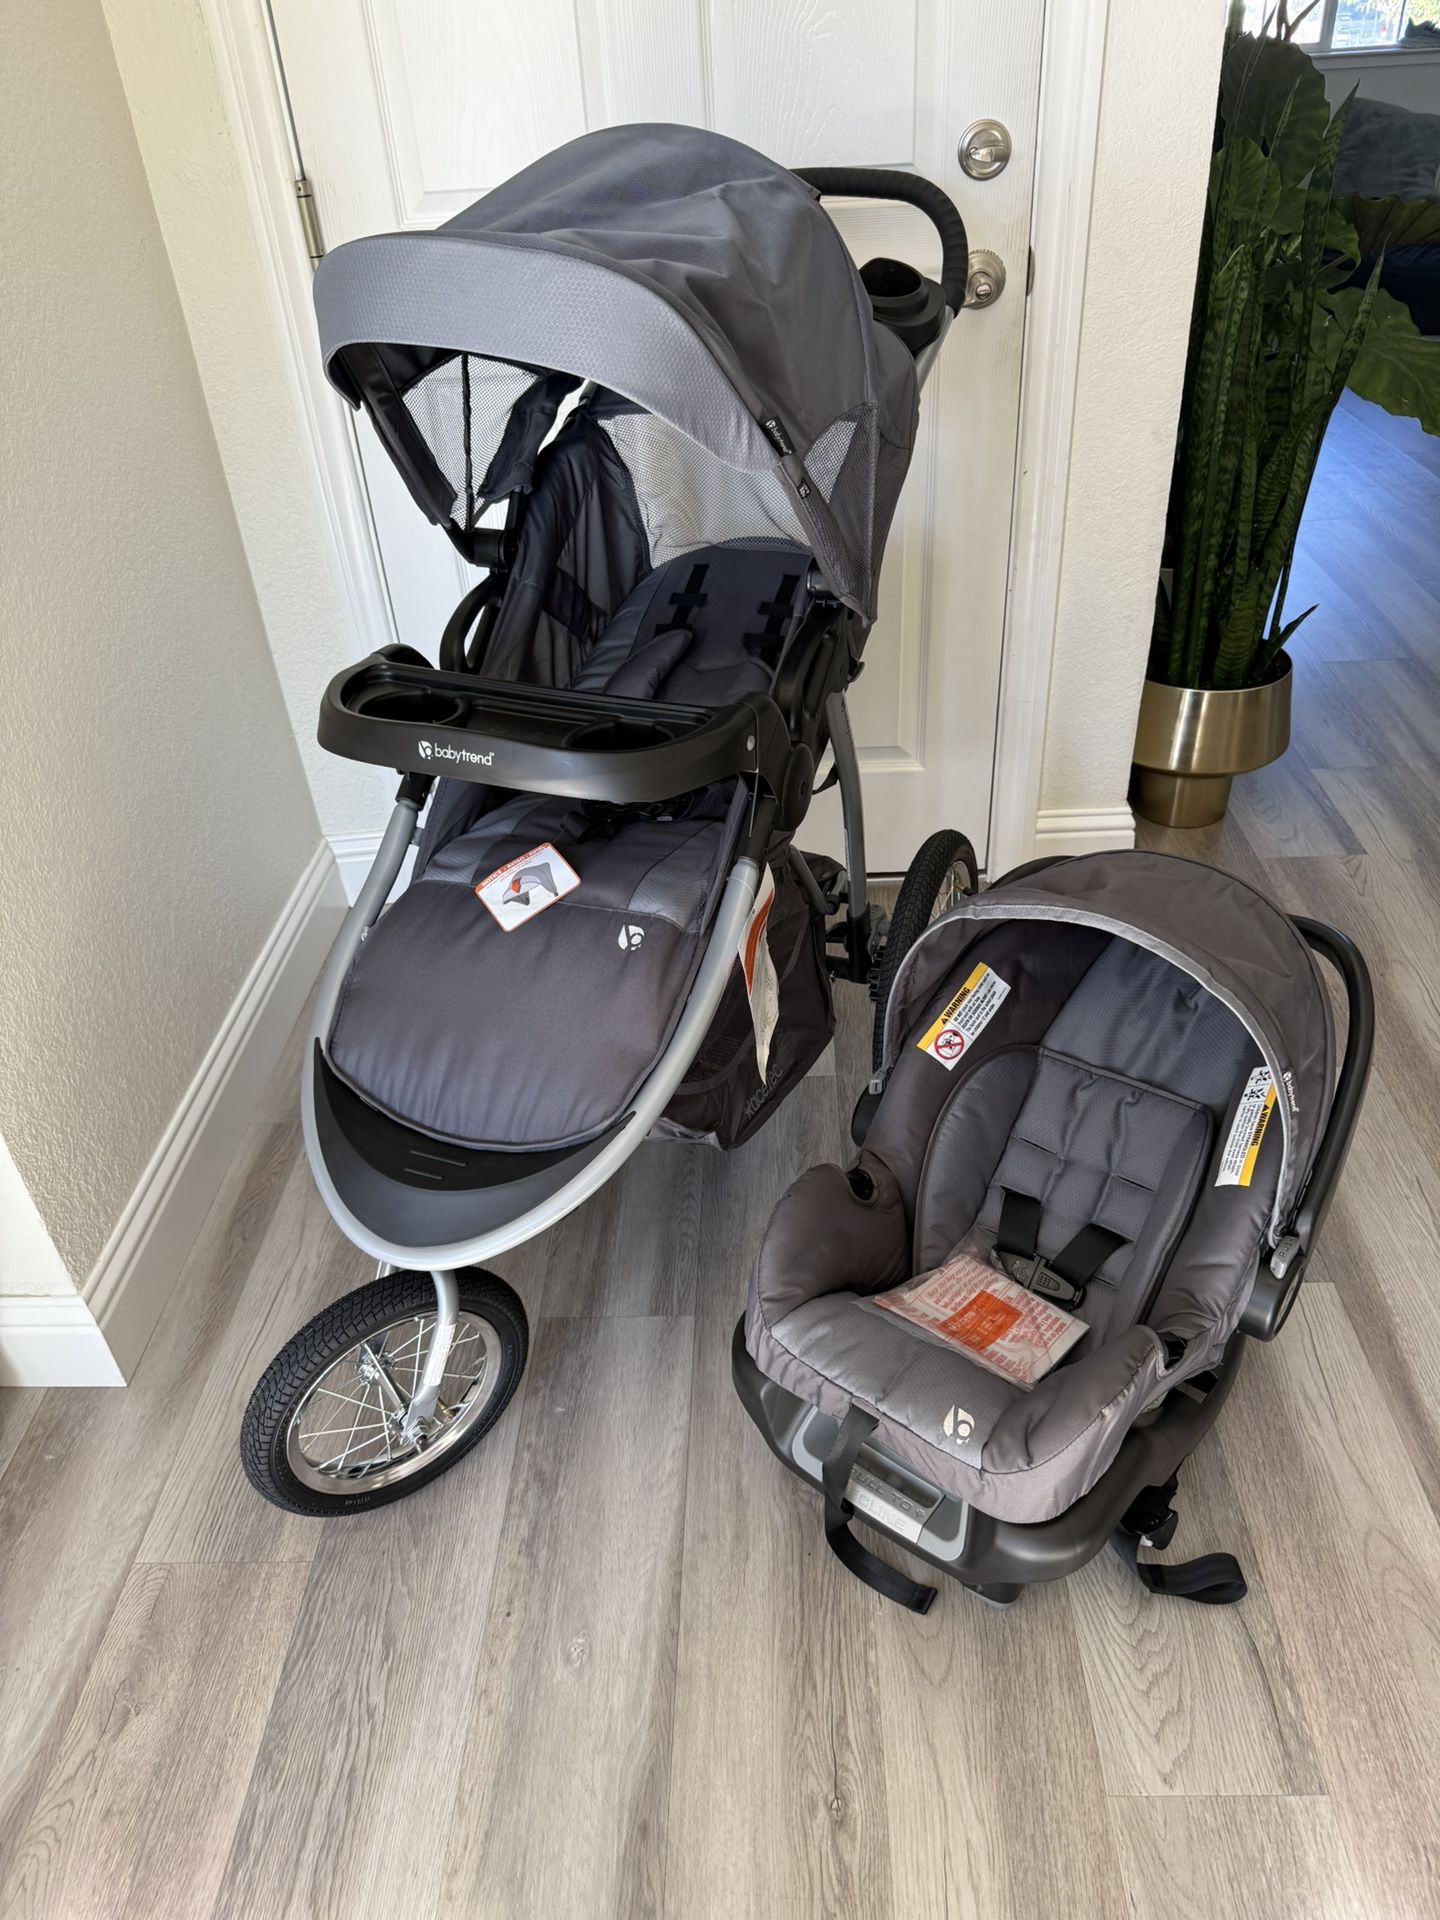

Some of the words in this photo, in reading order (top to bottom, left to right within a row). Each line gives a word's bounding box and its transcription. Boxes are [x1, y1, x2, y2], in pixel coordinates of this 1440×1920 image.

[434, 742, 495, 766] babytrend
[944, 986, 971, 1019] WARNING
[1250, 1112, 1267, 1146] WARNING
[890, 1492, 913, 1512] TO
